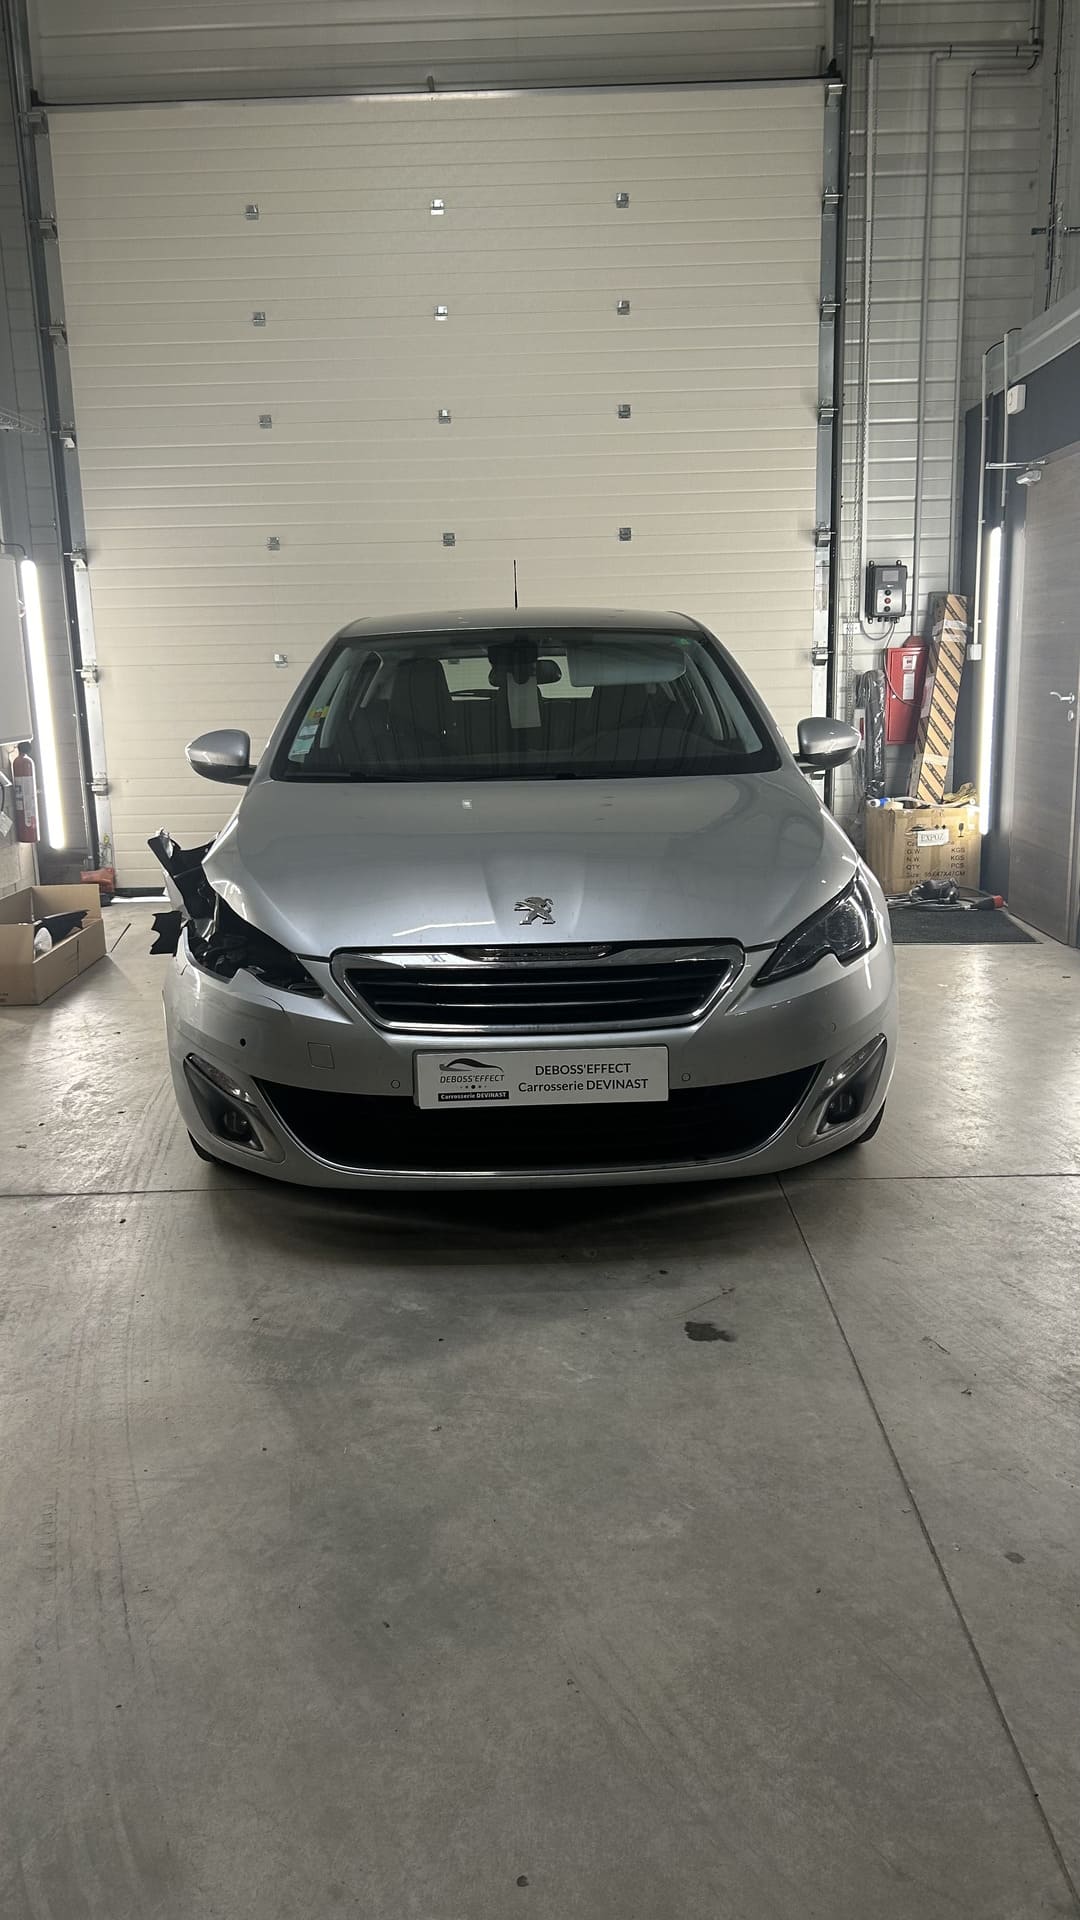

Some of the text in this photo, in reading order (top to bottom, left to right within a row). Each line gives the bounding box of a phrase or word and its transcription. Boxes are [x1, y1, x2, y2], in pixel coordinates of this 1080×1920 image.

[535, 1063, 631, 1076] DEBOSS'EFFECT
[440, 1074, 505, 1084] DEBOSS'EFFECT
[518, 1078, 649, 1092] Carrosserie DEVINAST
